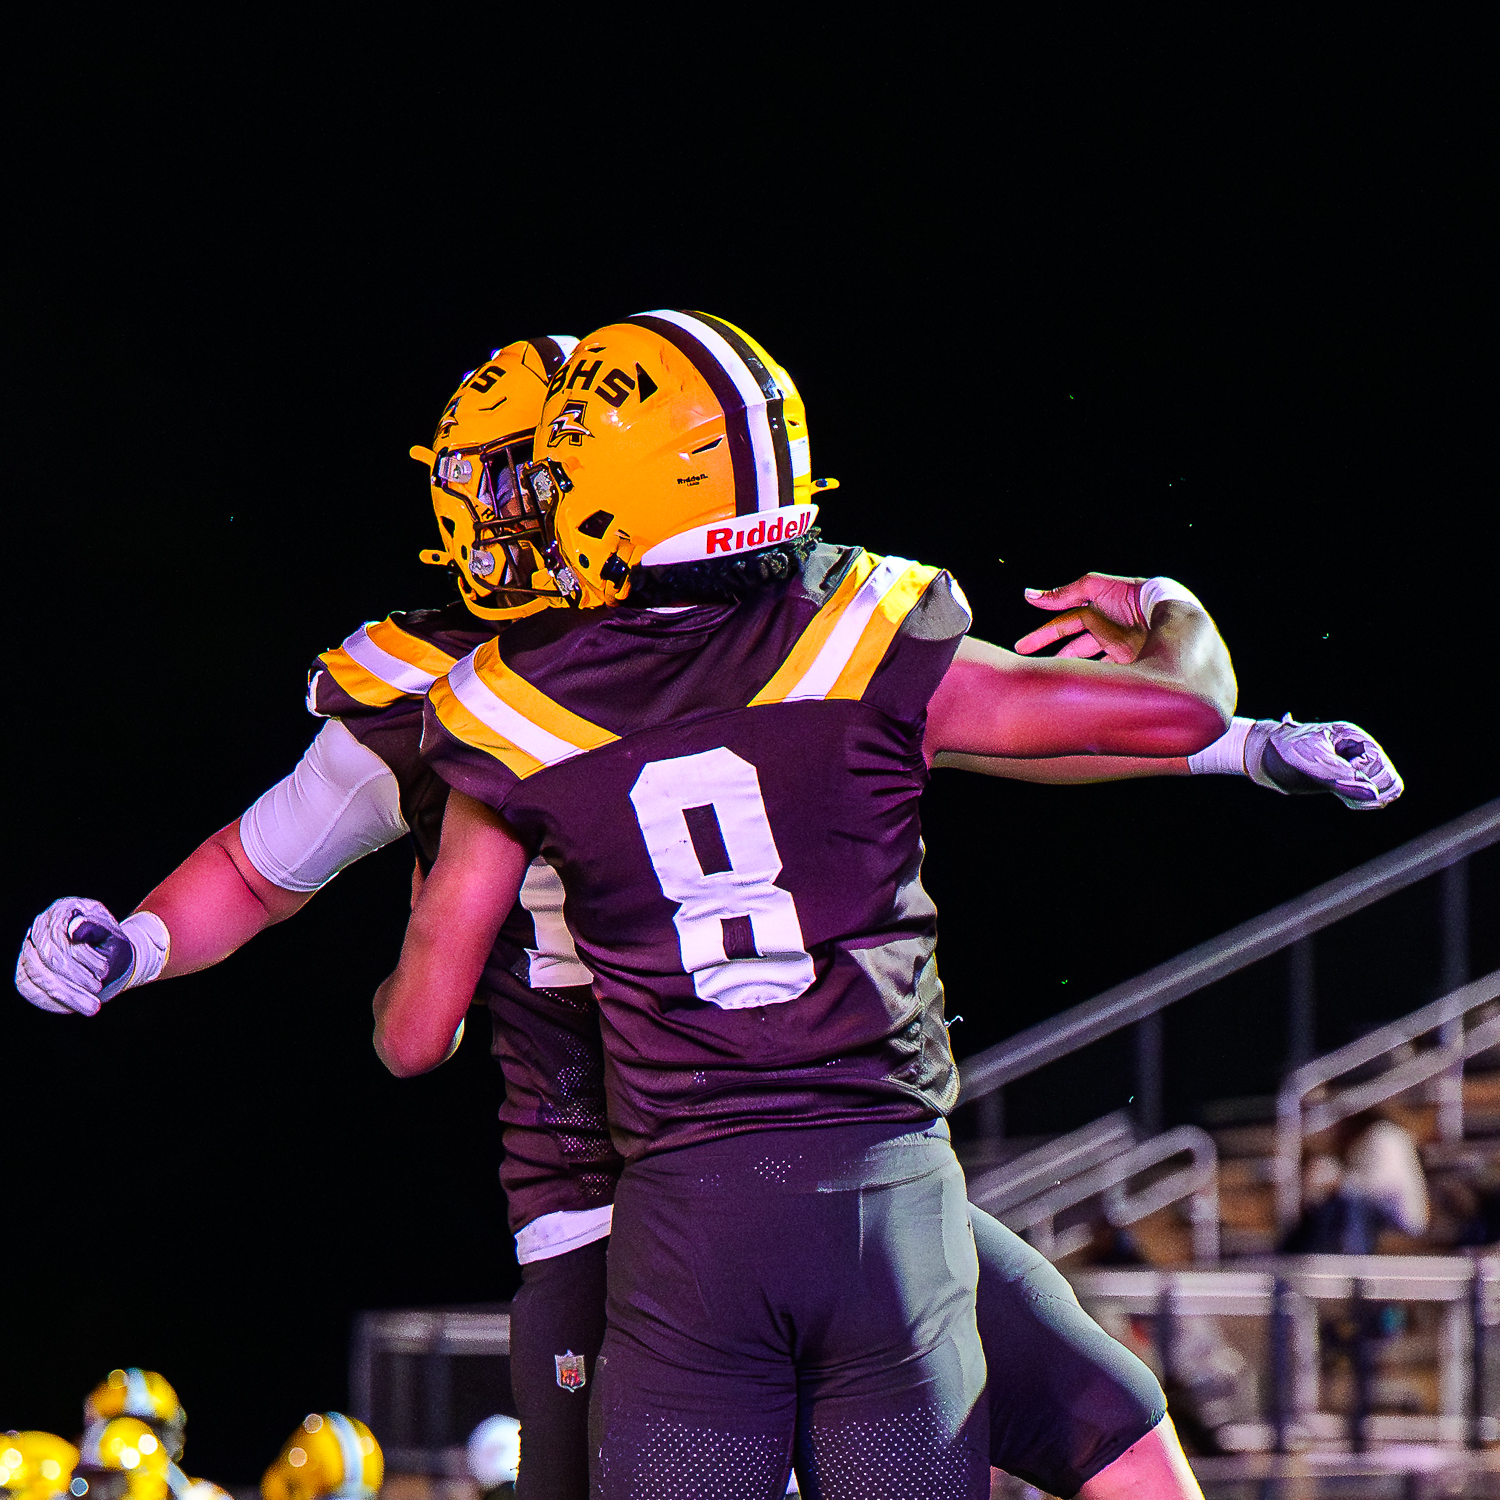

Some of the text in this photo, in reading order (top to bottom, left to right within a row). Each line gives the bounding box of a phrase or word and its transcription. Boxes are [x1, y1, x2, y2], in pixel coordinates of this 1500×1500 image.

[545, 359, 636, 408] BHS
[706, 511, 811, 555] Riddell
[629, 746, 818, 1011] 8
